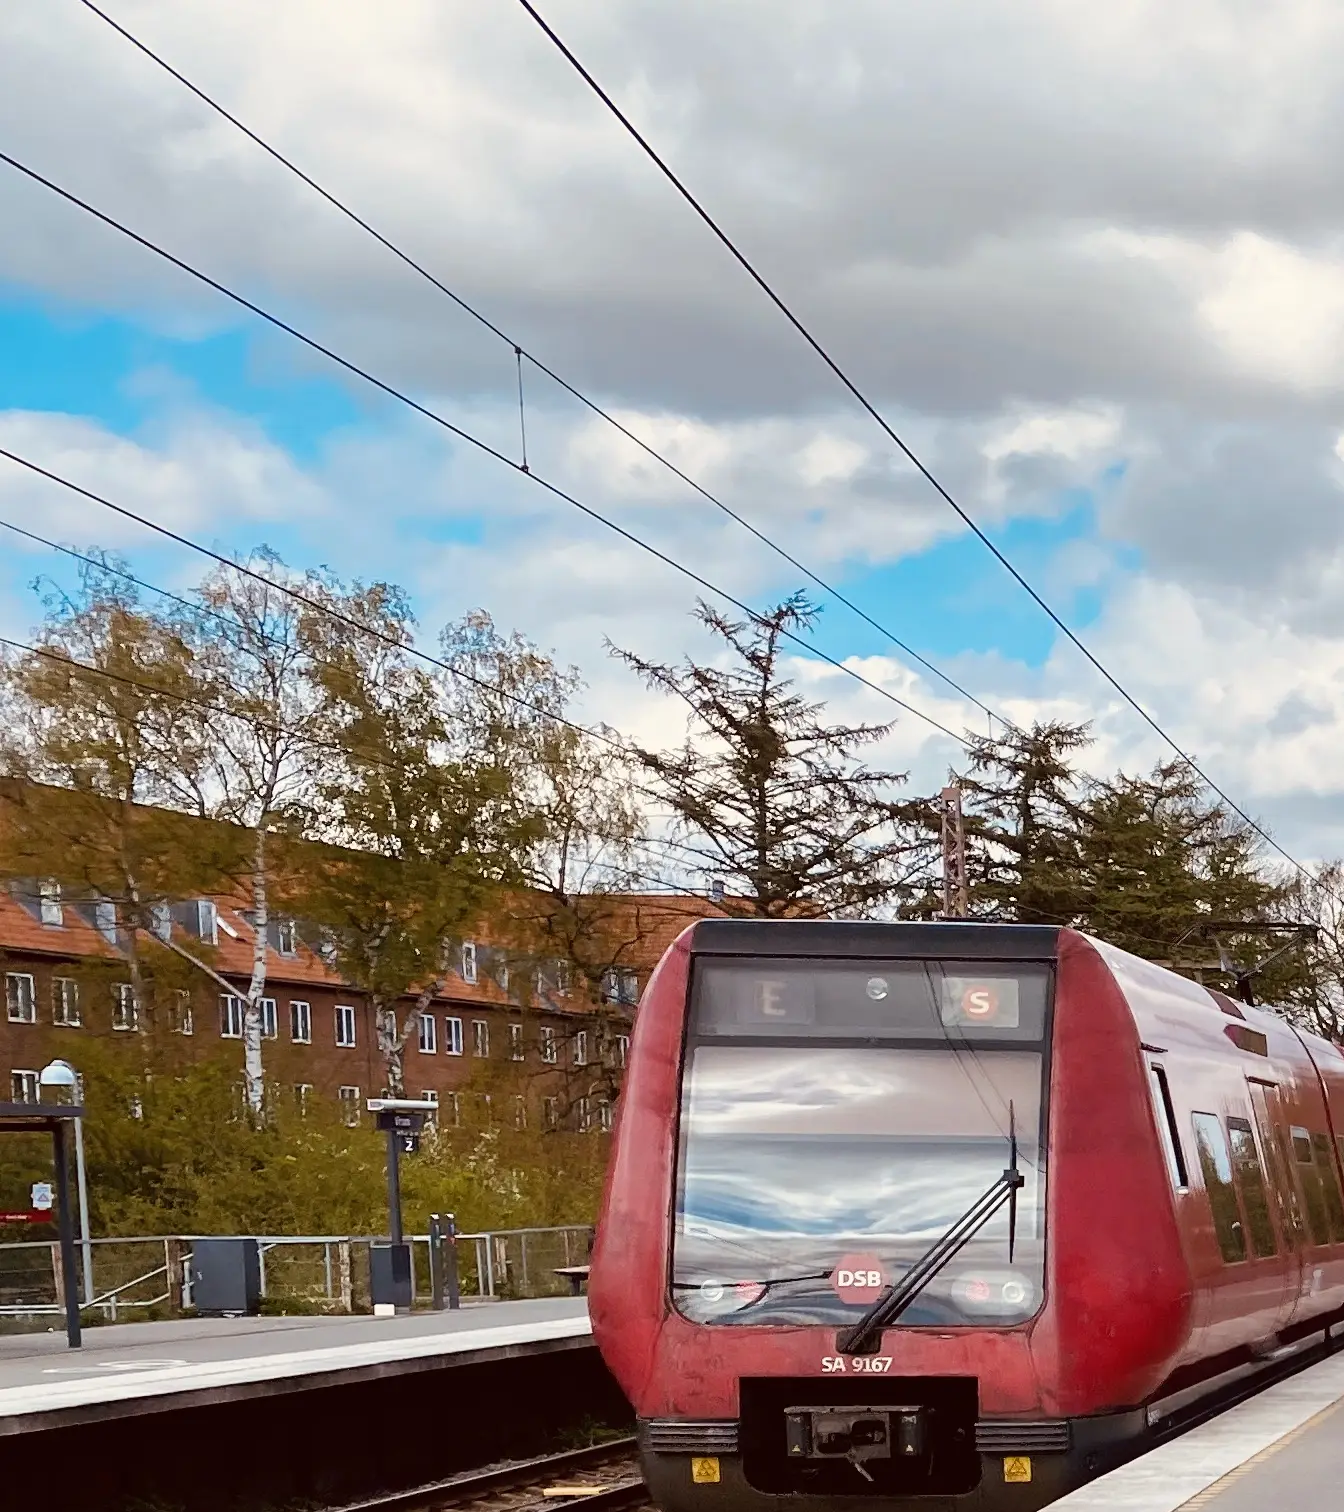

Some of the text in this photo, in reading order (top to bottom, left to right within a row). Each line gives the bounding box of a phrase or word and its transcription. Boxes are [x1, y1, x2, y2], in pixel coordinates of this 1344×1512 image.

[754, 980, 788, 1017] E
[405, 1140, 414, 1152] 2
[837, 1270, 882, 1288] DSB
[821, 1356, 893, 1373] SA 9167
